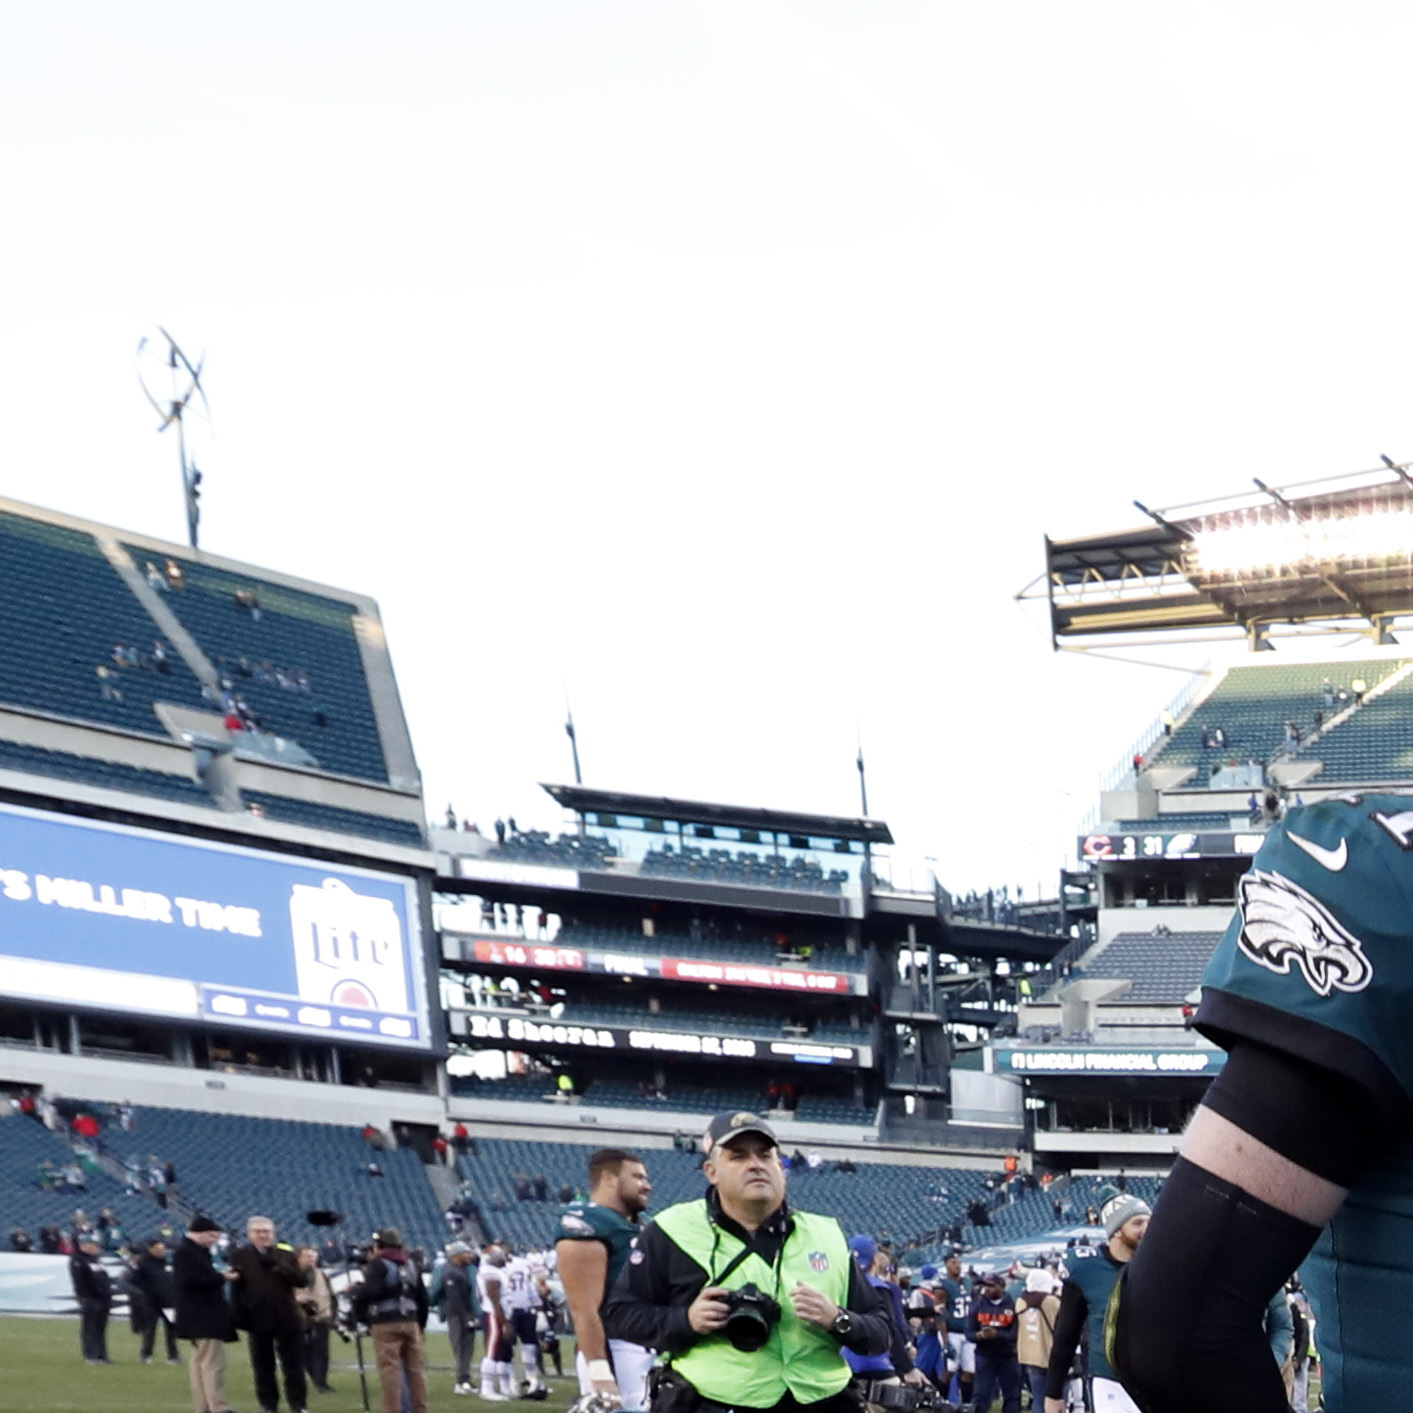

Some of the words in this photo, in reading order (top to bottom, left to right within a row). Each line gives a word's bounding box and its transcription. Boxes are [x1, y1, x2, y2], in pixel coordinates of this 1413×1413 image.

[35, 874, 173, 923] MILLER
[174, 896, 262, 937] TIME
[310, 921, 389, 969] Lite
[469, 1015, 504, 1039] Ed
[507, 1018, 616, 1048] Sheeran
[1026, 1053, 1086, 1070] LINCOLN
[1086, 1053, 1157, 1071] FINANCIAL
[1157, 1053, 1209, 1071] GROUP
